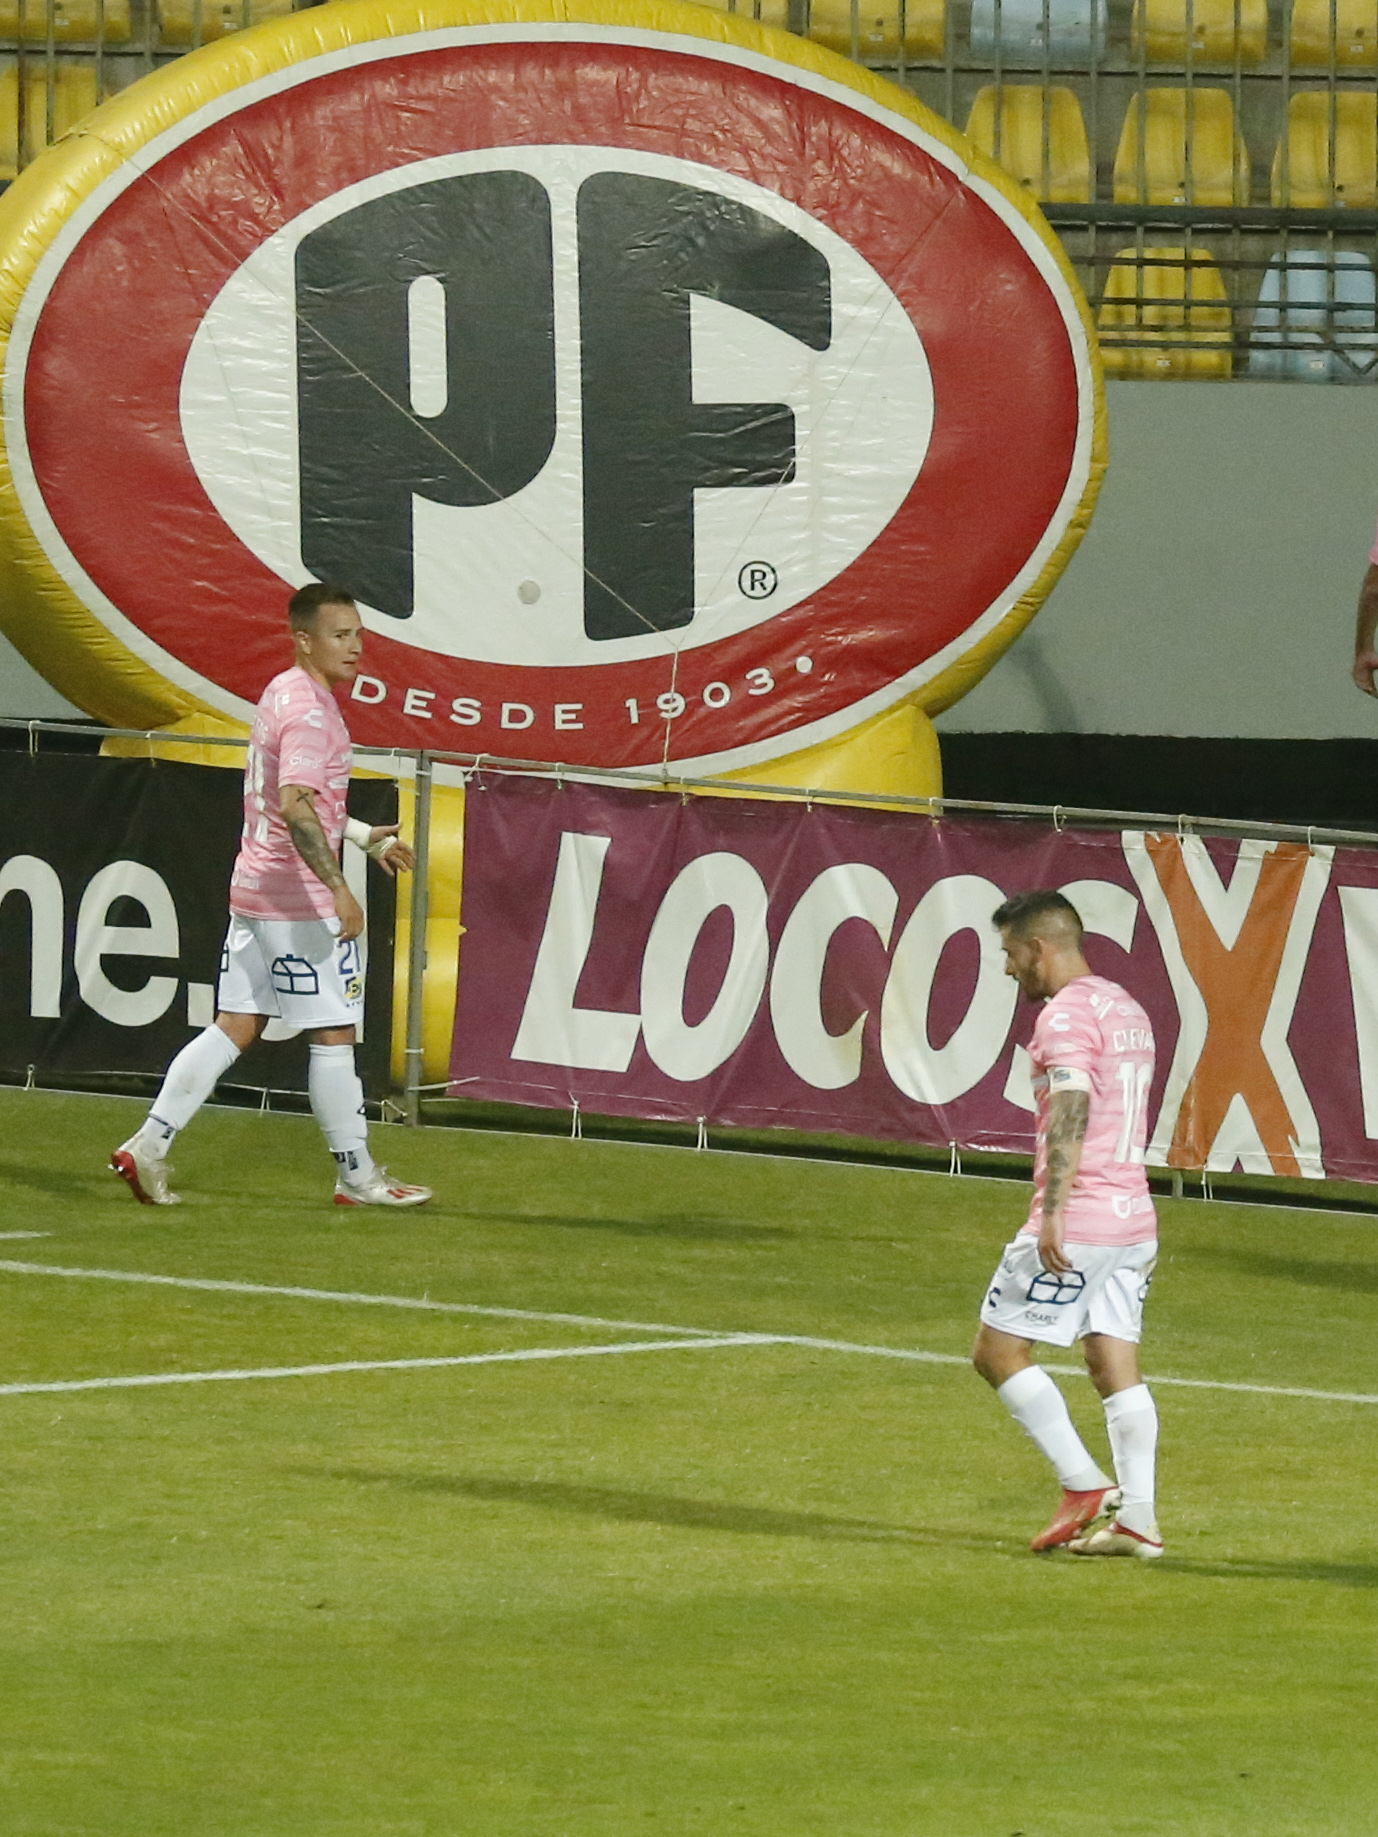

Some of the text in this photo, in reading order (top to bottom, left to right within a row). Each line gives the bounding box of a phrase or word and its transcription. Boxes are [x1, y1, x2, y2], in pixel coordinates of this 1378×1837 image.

[294, 170, 832, 642] PF
[350, 666, 777, 731] DESDE 1903
